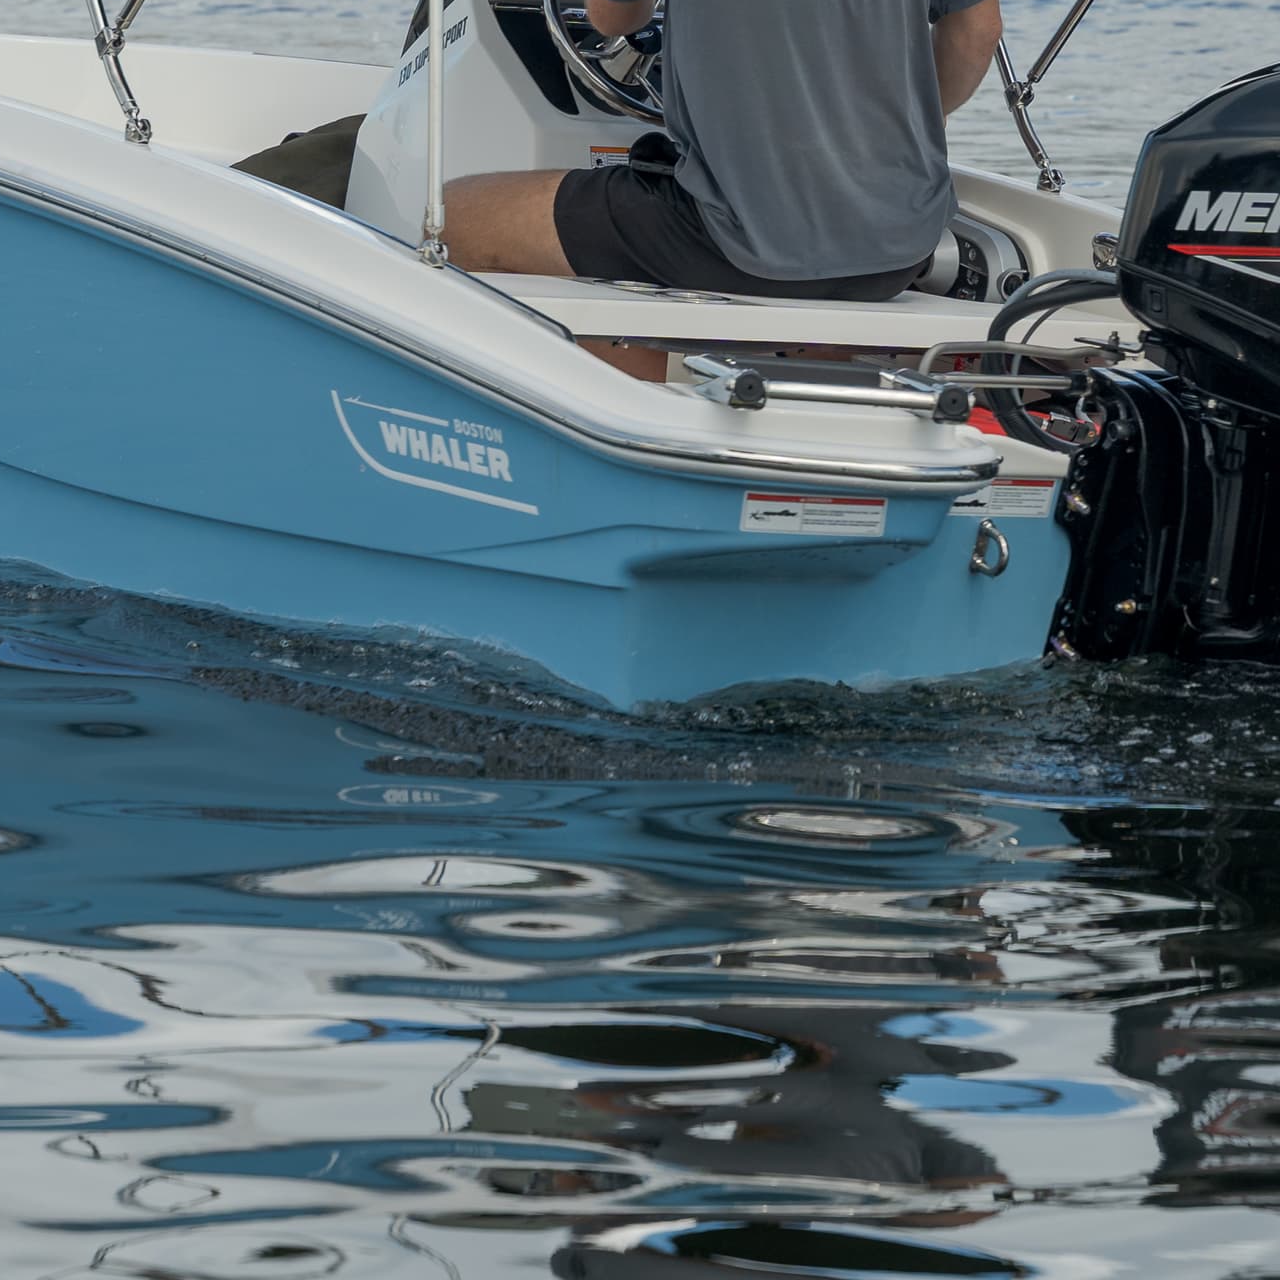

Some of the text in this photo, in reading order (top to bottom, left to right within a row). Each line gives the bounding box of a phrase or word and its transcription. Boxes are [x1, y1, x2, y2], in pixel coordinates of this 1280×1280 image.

[398, 61, 412, 88] 130
[452, 418, 504, 444] BOSTON
[378, 420, 513, 482] WHALER
